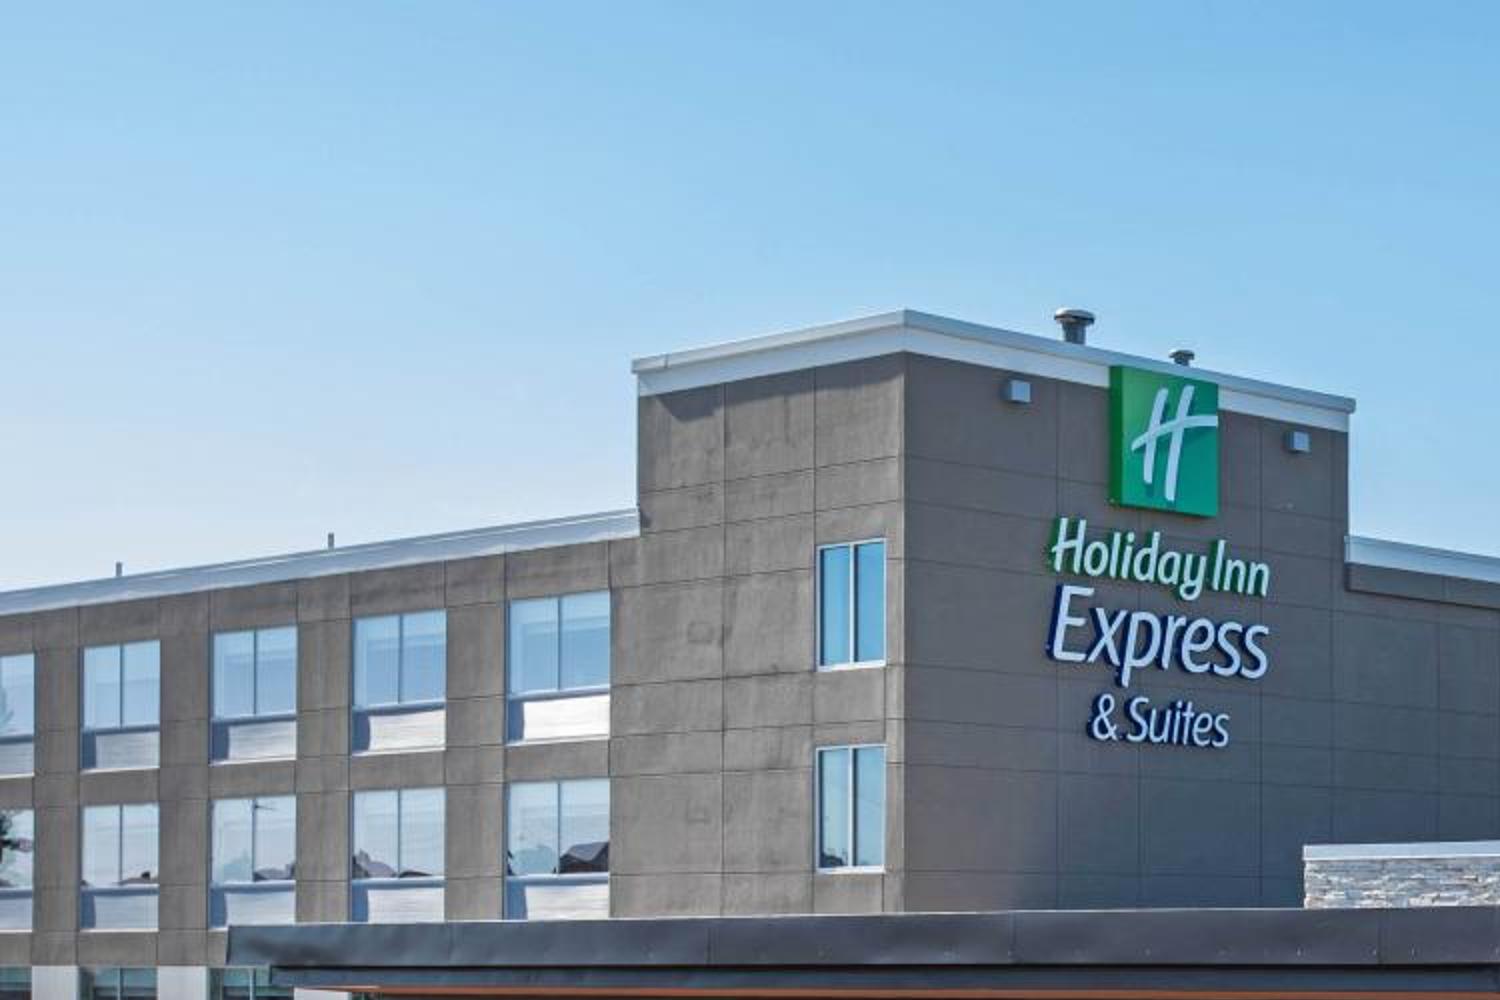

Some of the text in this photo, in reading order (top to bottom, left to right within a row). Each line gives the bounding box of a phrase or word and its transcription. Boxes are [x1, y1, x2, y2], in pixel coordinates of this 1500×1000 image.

[1131, 384, 1218, 502] H
[1050, 517, 1271, 601] Holiday Inn
[1050, 585, 1270, 688] Express
[1091, 693, 1230, 747] & Suites
